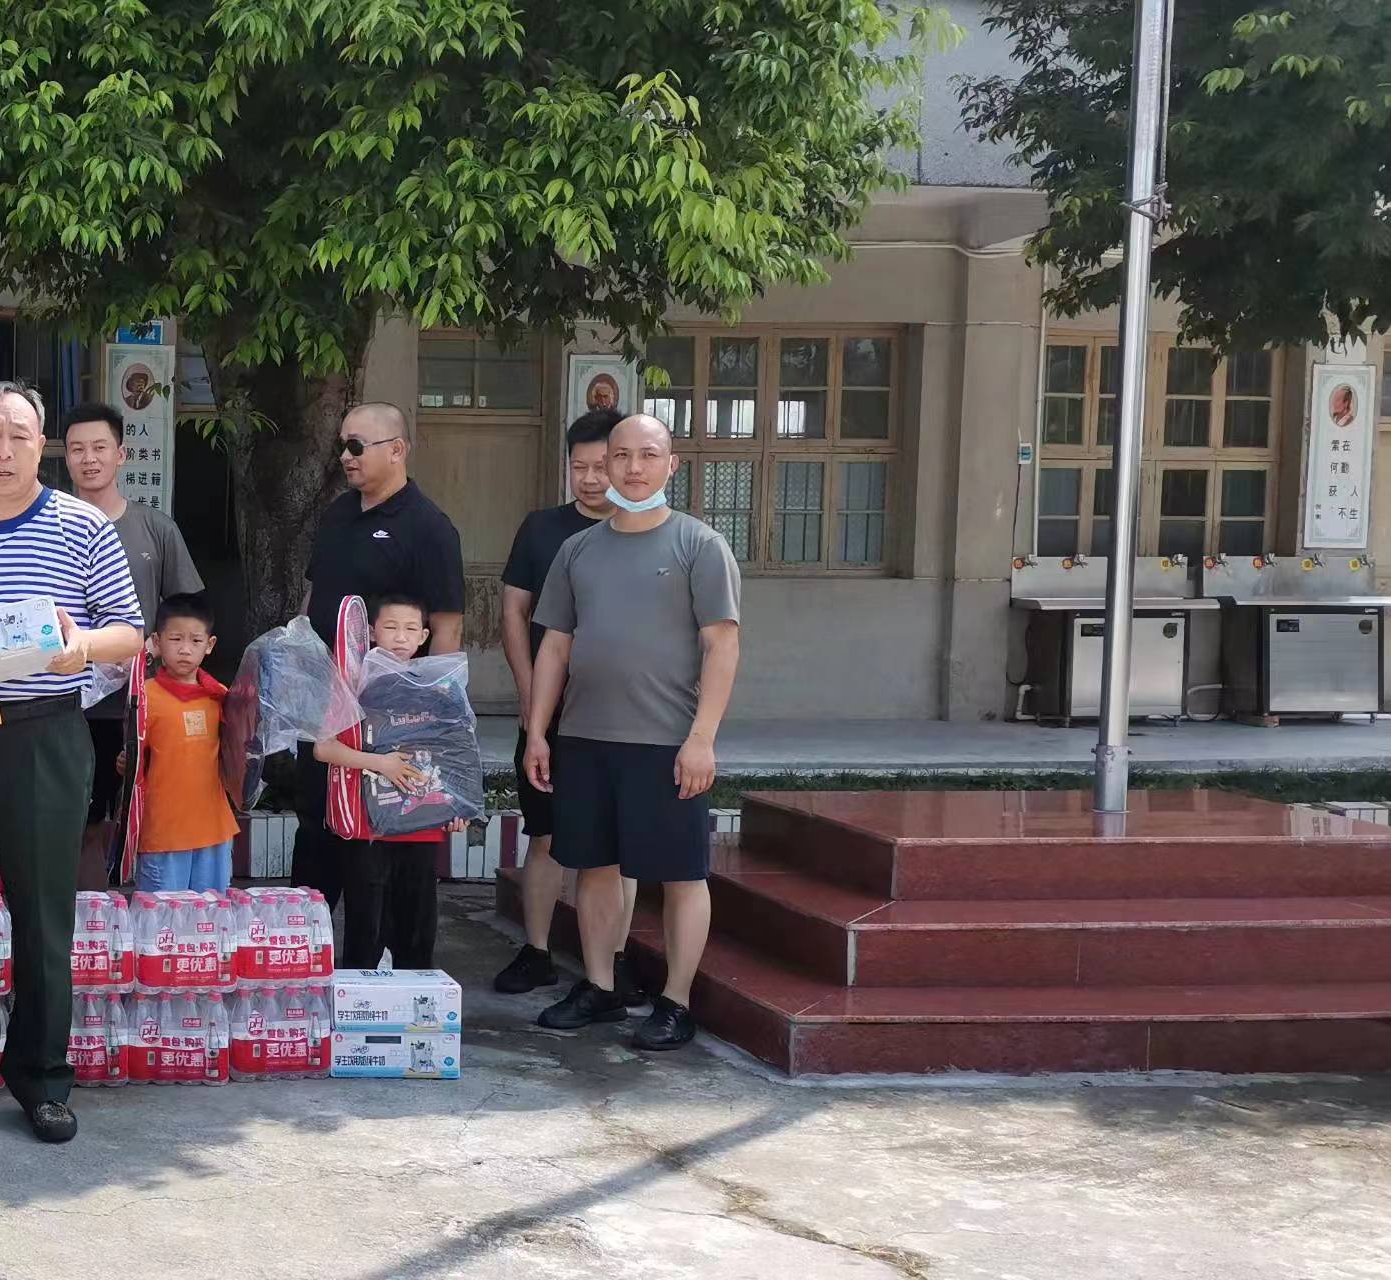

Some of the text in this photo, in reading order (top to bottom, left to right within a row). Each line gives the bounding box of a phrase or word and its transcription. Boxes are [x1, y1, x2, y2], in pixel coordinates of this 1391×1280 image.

[269, 949, 309, 965] 更优惠
[176, 958, 217, 973] 更优惠
[266, 1042, 308, 1058] 更优惠
[161, 1051, 204, 1067] 更优惠
